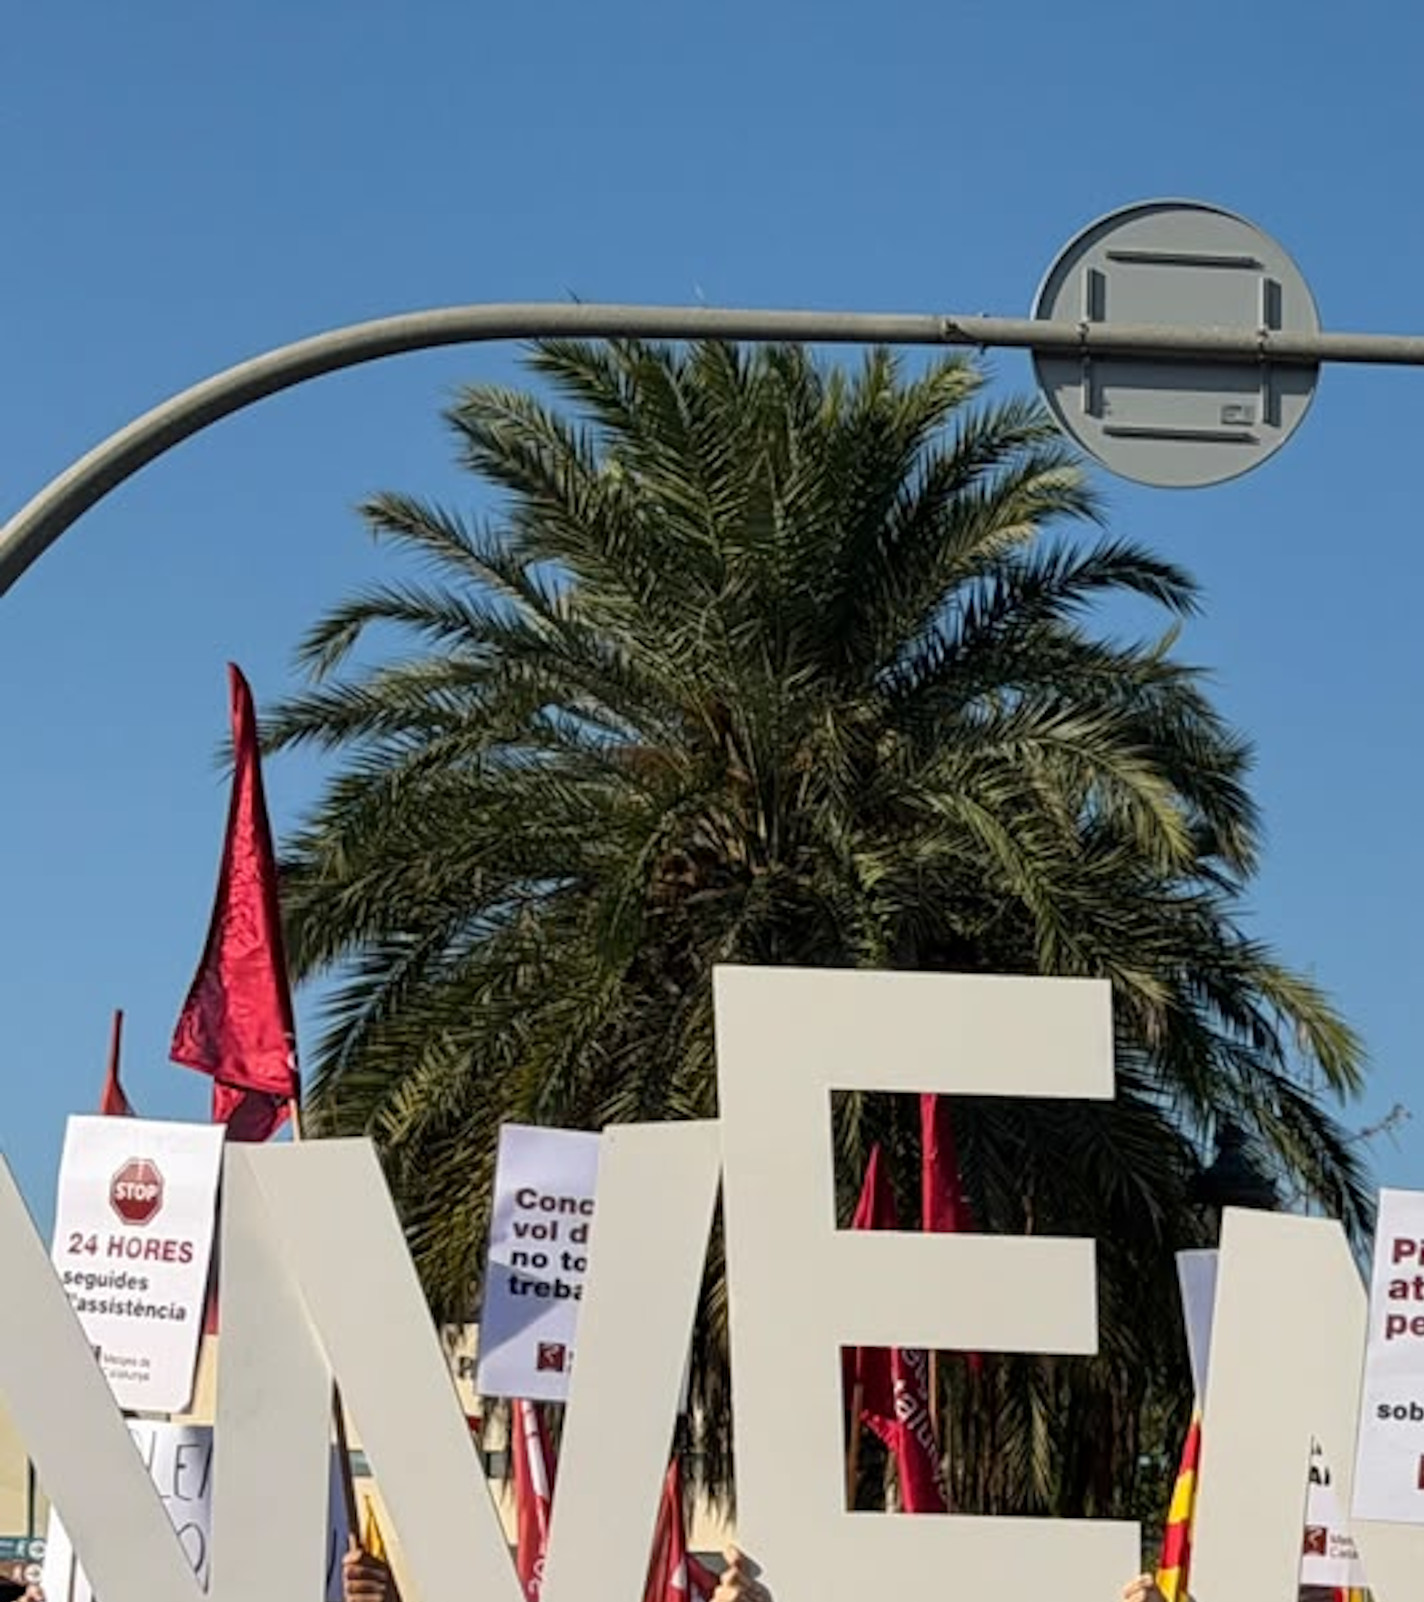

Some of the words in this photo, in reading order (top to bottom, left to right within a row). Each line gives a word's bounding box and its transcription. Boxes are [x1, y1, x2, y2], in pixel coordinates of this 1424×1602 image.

[113, 1182, 159, 1201] STOP
[513, 1220, 558, 1241] vol
[68, 1232, 98, 1255] 24
[107, 1235, 194, 1264] HORES
[510, 1250, 548, 1268] no
[62, 1269, 149, 1291] seguides
[65, 1292, 187, 1322] 'assistència
